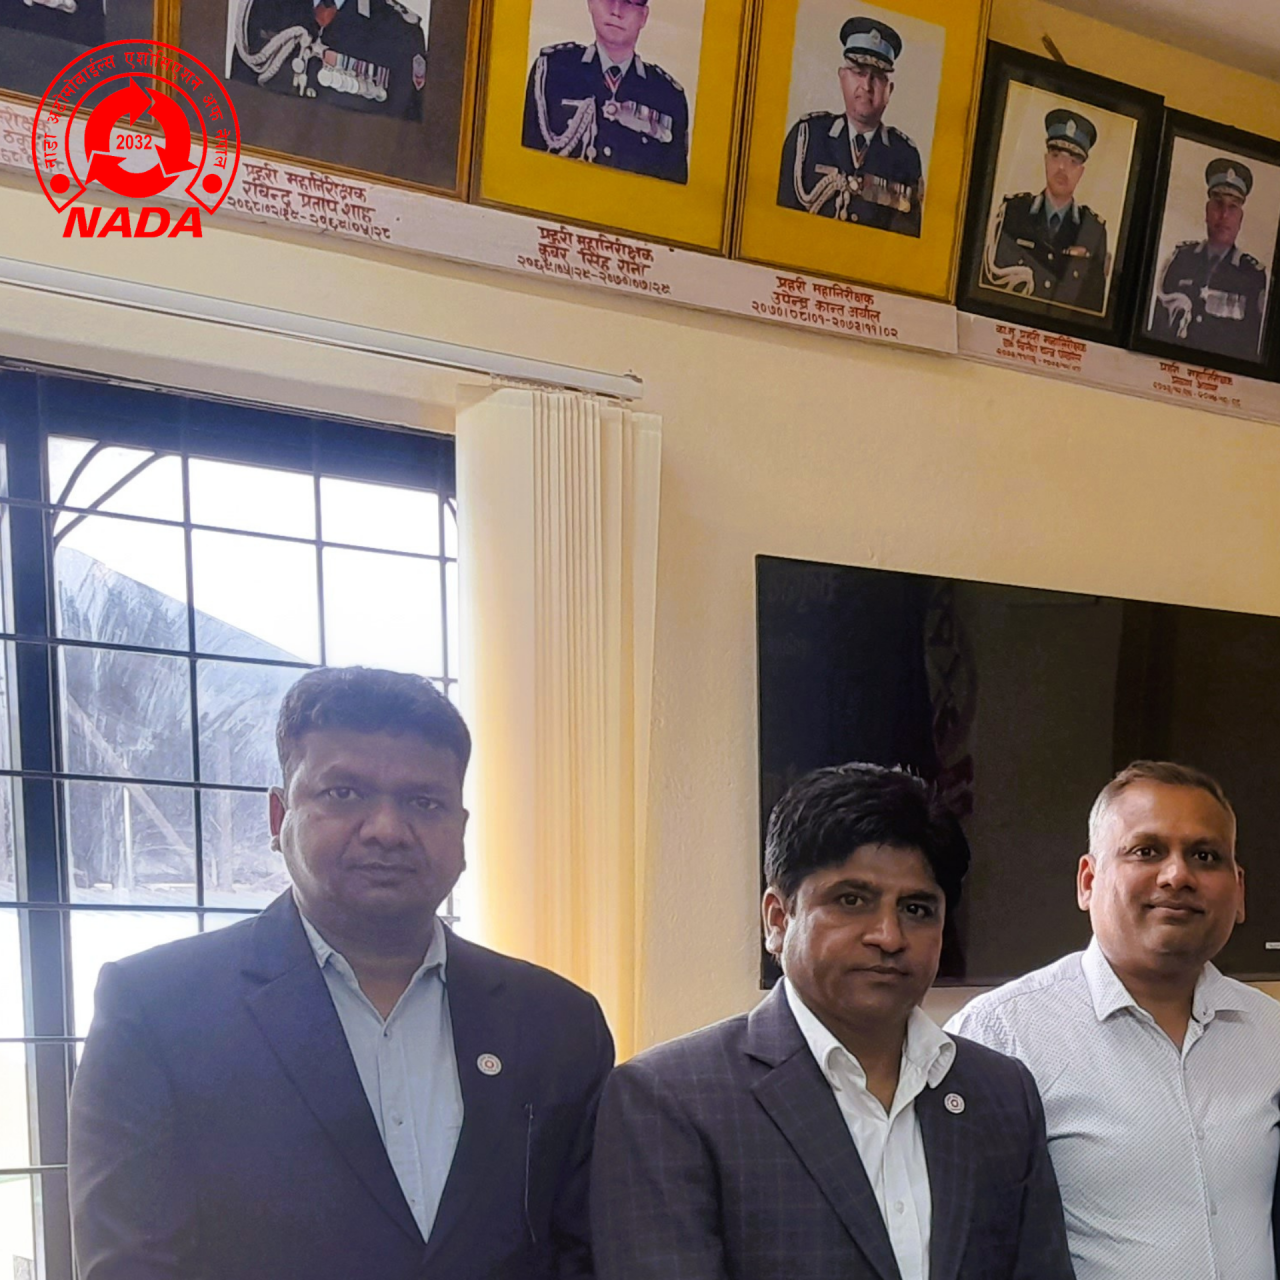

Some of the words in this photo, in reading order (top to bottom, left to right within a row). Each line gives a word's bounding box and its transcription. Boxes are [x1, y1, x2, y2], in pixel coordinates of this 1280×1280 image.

[242, 162, 278, 184] प्रहरी
[284, 171, 367, 203] महानिरीक्षक
[298, 192, 339, 216] प्रताप
[341, 203, 376, 224] शाह
[537, 225, 574, 248] प्रहरी
[576, 233, 655, 263] महानिरीक्षक
[771, 290, 810, 310] उपेन्द्र
[815, 300, 845, 316] कान्त
[776, 275, 807, 294] प्रहरी
[812, 283, 874, 306] महानिरीक्षक
